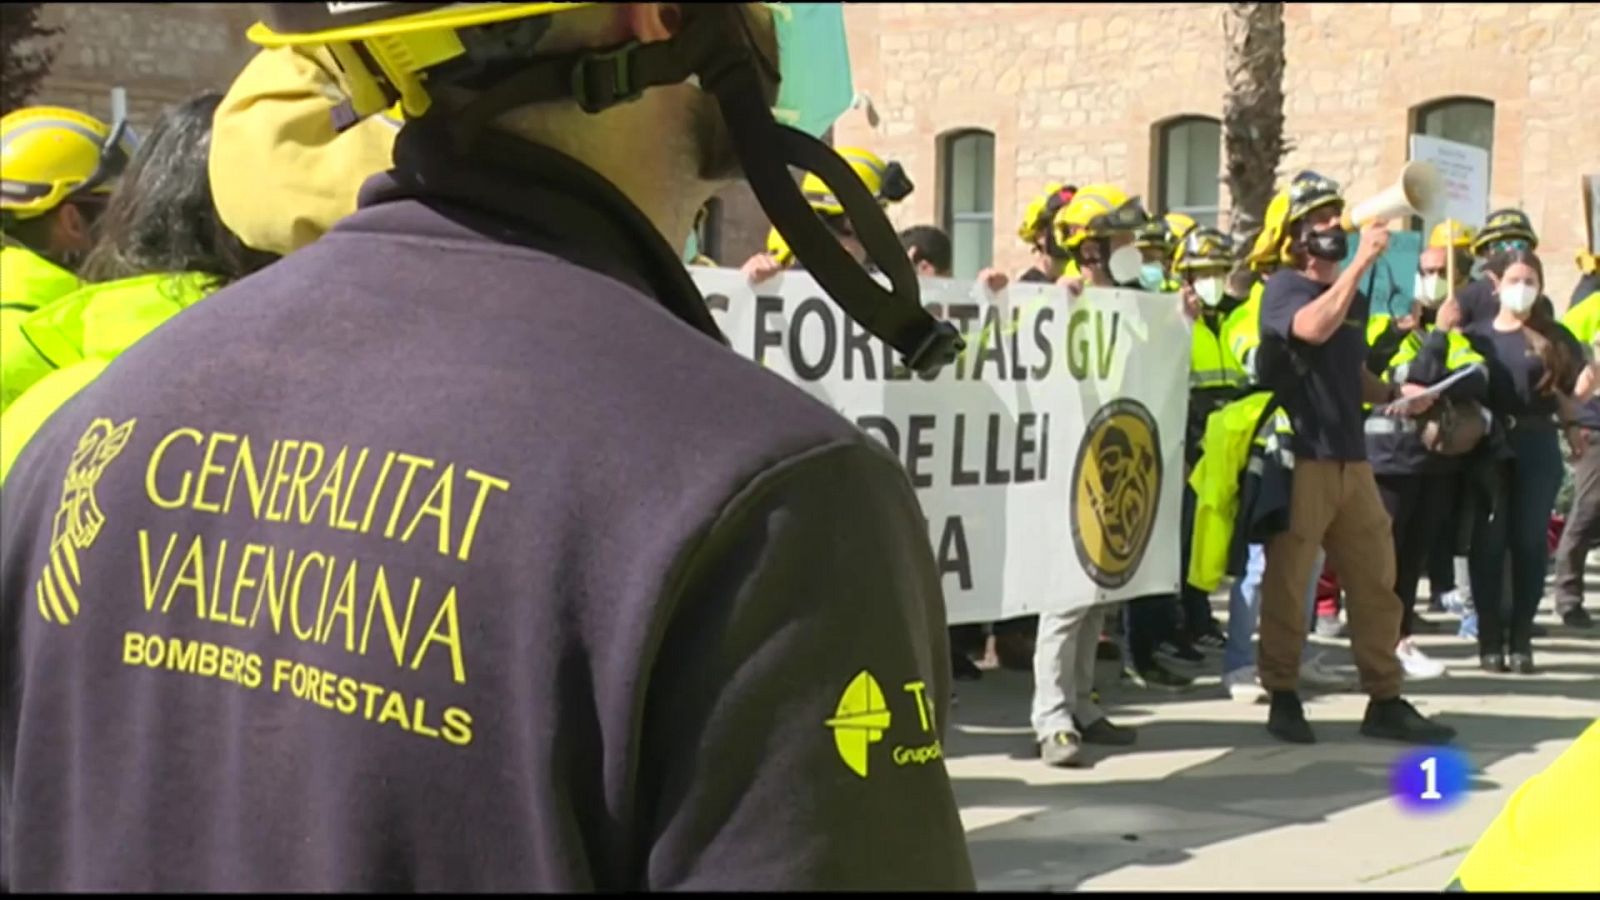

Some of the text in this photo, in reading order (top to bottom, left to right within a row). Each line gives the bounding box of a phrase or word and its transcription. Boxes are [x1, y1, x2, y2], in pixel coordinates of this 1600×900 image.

[753, 294, 1120, 382] FORTALS GV
[145, 427, 510, 562] GENERALITAT
[951, 412, 1050, 486] LLEI
[925, 515, 973, 590] A
[138, 529, 466, 684] VALENCIANA
[122, 631, 475, 746] BOMBERS FORESTALS
